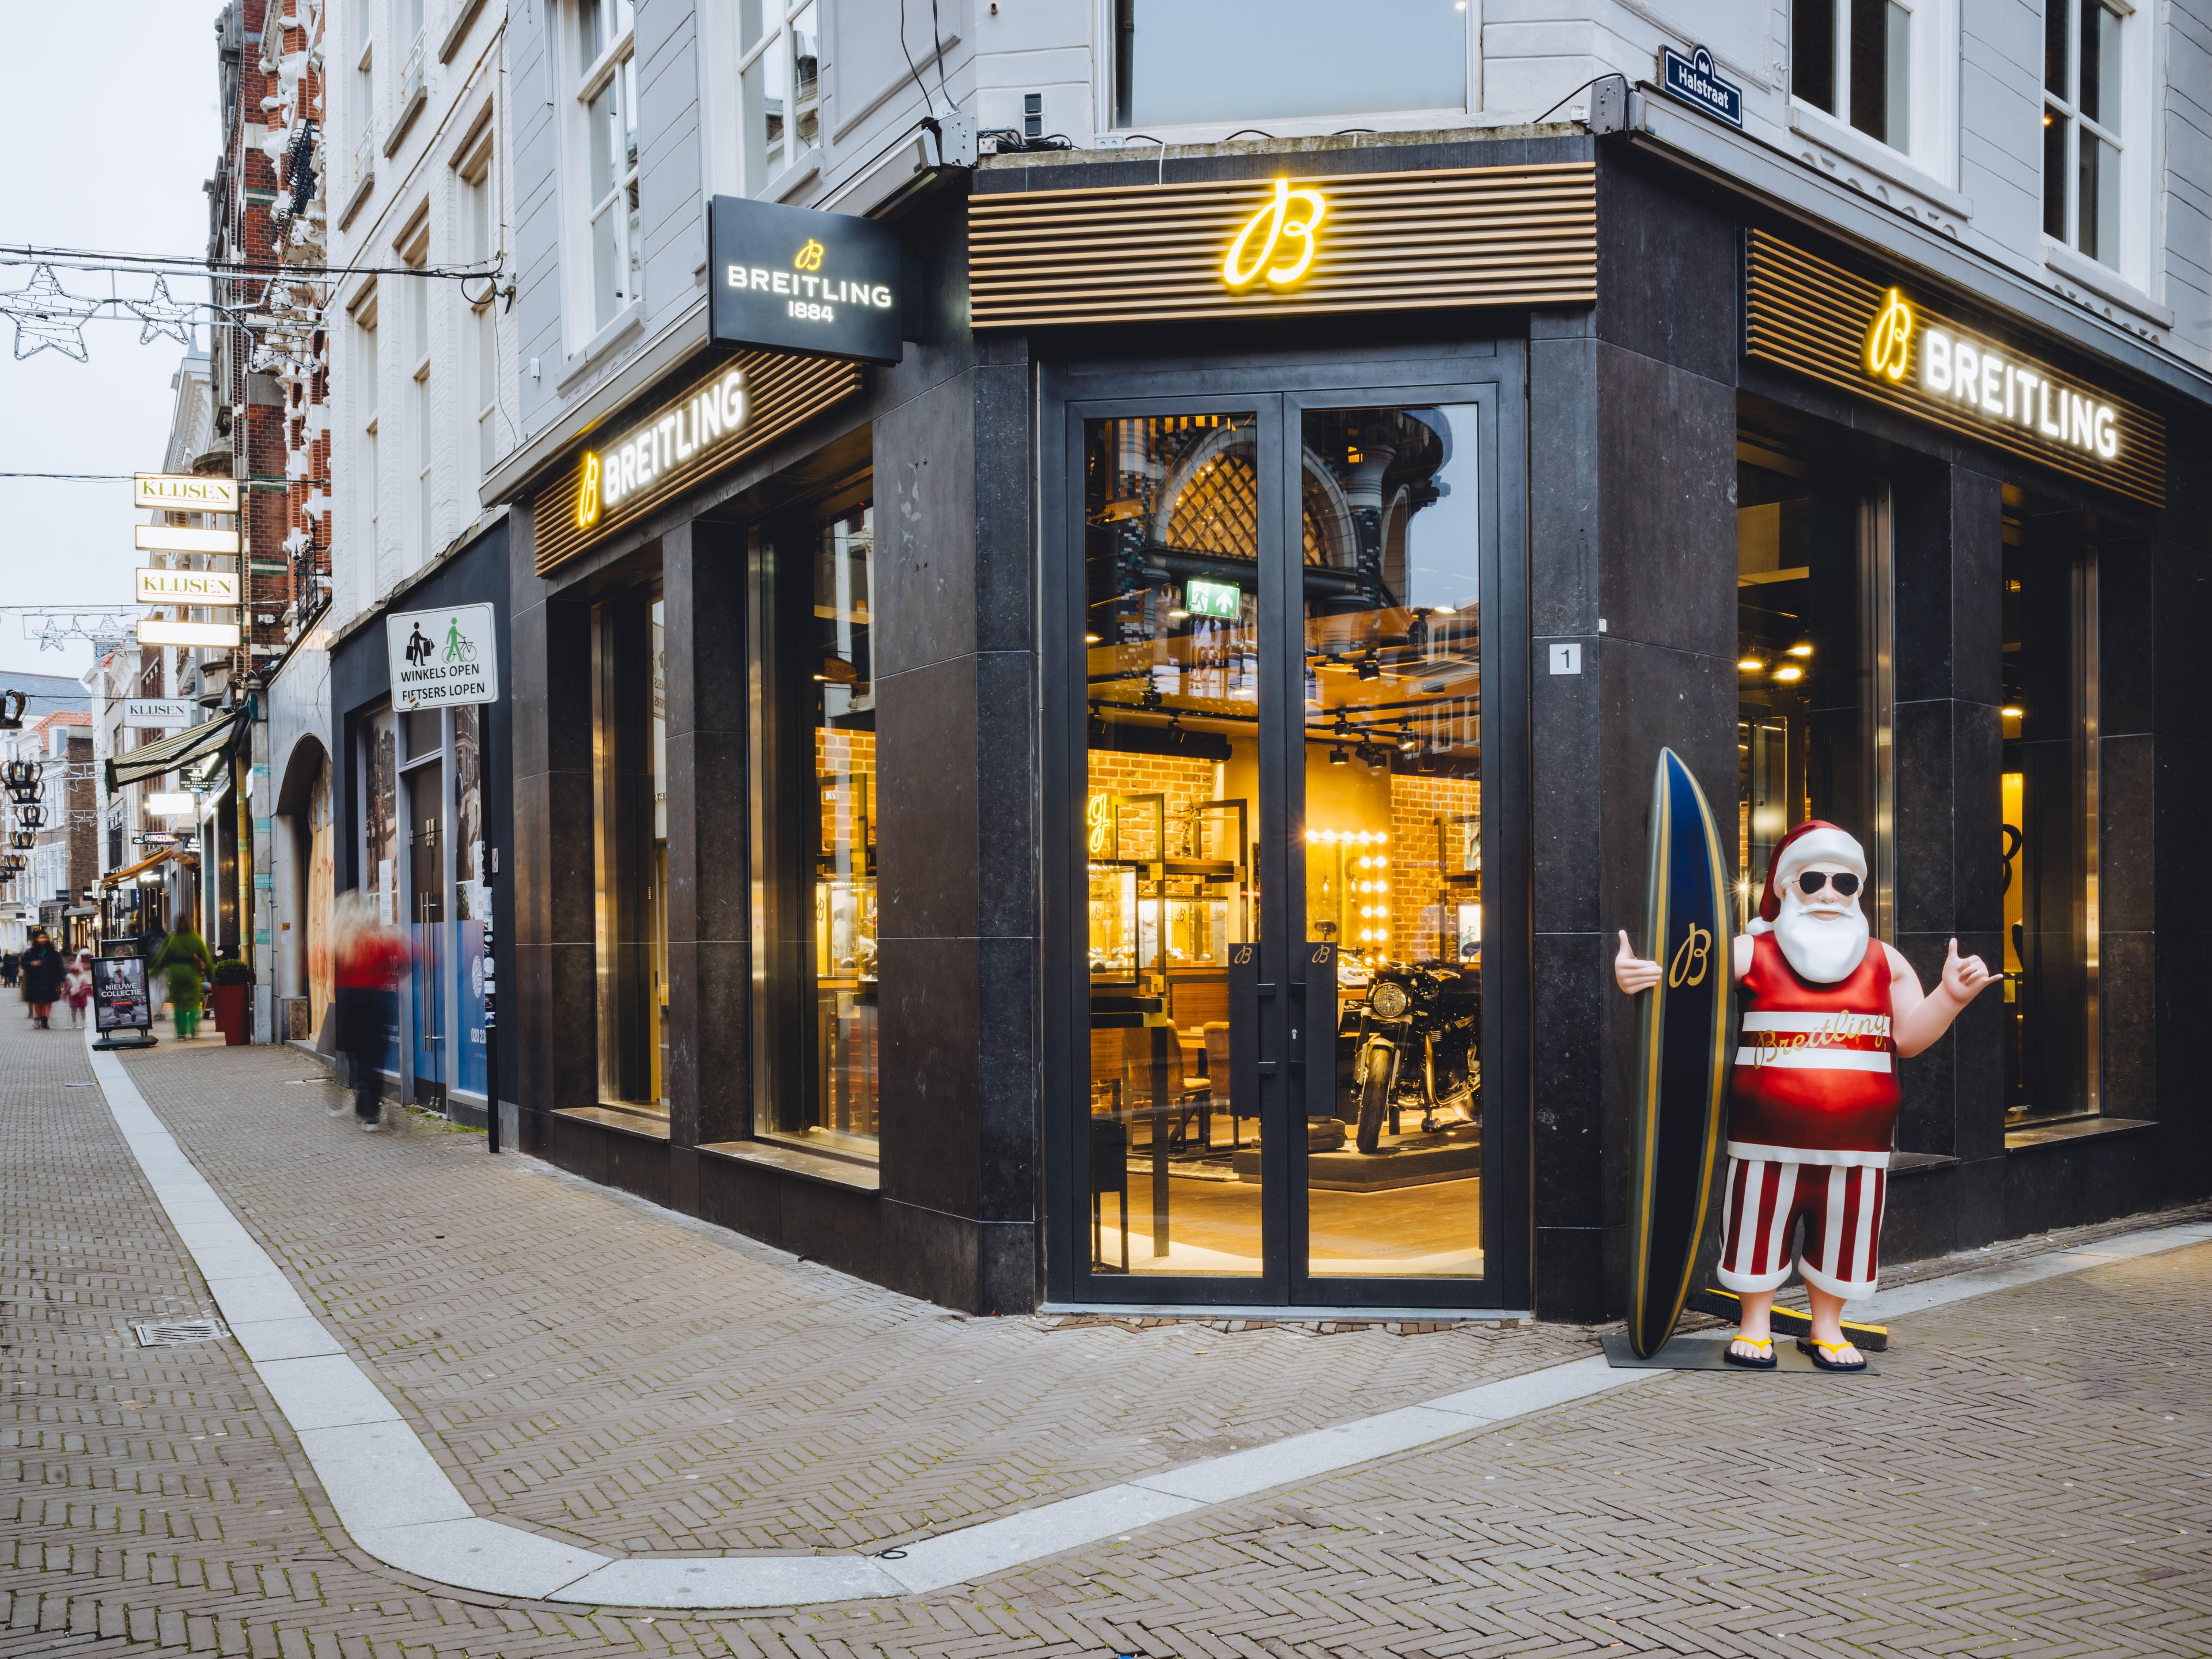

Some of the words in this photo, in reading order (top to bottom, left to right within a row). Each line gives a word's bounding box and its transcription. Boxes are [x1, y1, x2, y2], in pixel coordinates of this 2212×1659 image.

[1679, 65, 1728, 109] Halstraat
[728, 266, 892, 308] BREITLING
[789, 302, 833, 323] 1884
[1926, 329, 2118, 458] BREITLING
[605, 372, 744, 504] BREITLING
[142, 480, 230, 500] KLIJSEN
[143, 576, 232, 594] KLIJSEN
[1560, 649, 1569, 668] 1
[401, 667, 446, 682] WINKELS
[449, 664, 479, 677] OPEN
[449, 682, 484, 696] LOPEN
[130, 705, 184, 714] KLIJSEN
[101, 989, 142, 997] COLLECTIE
[1753, 1010, 1886, 1069] Breitling
